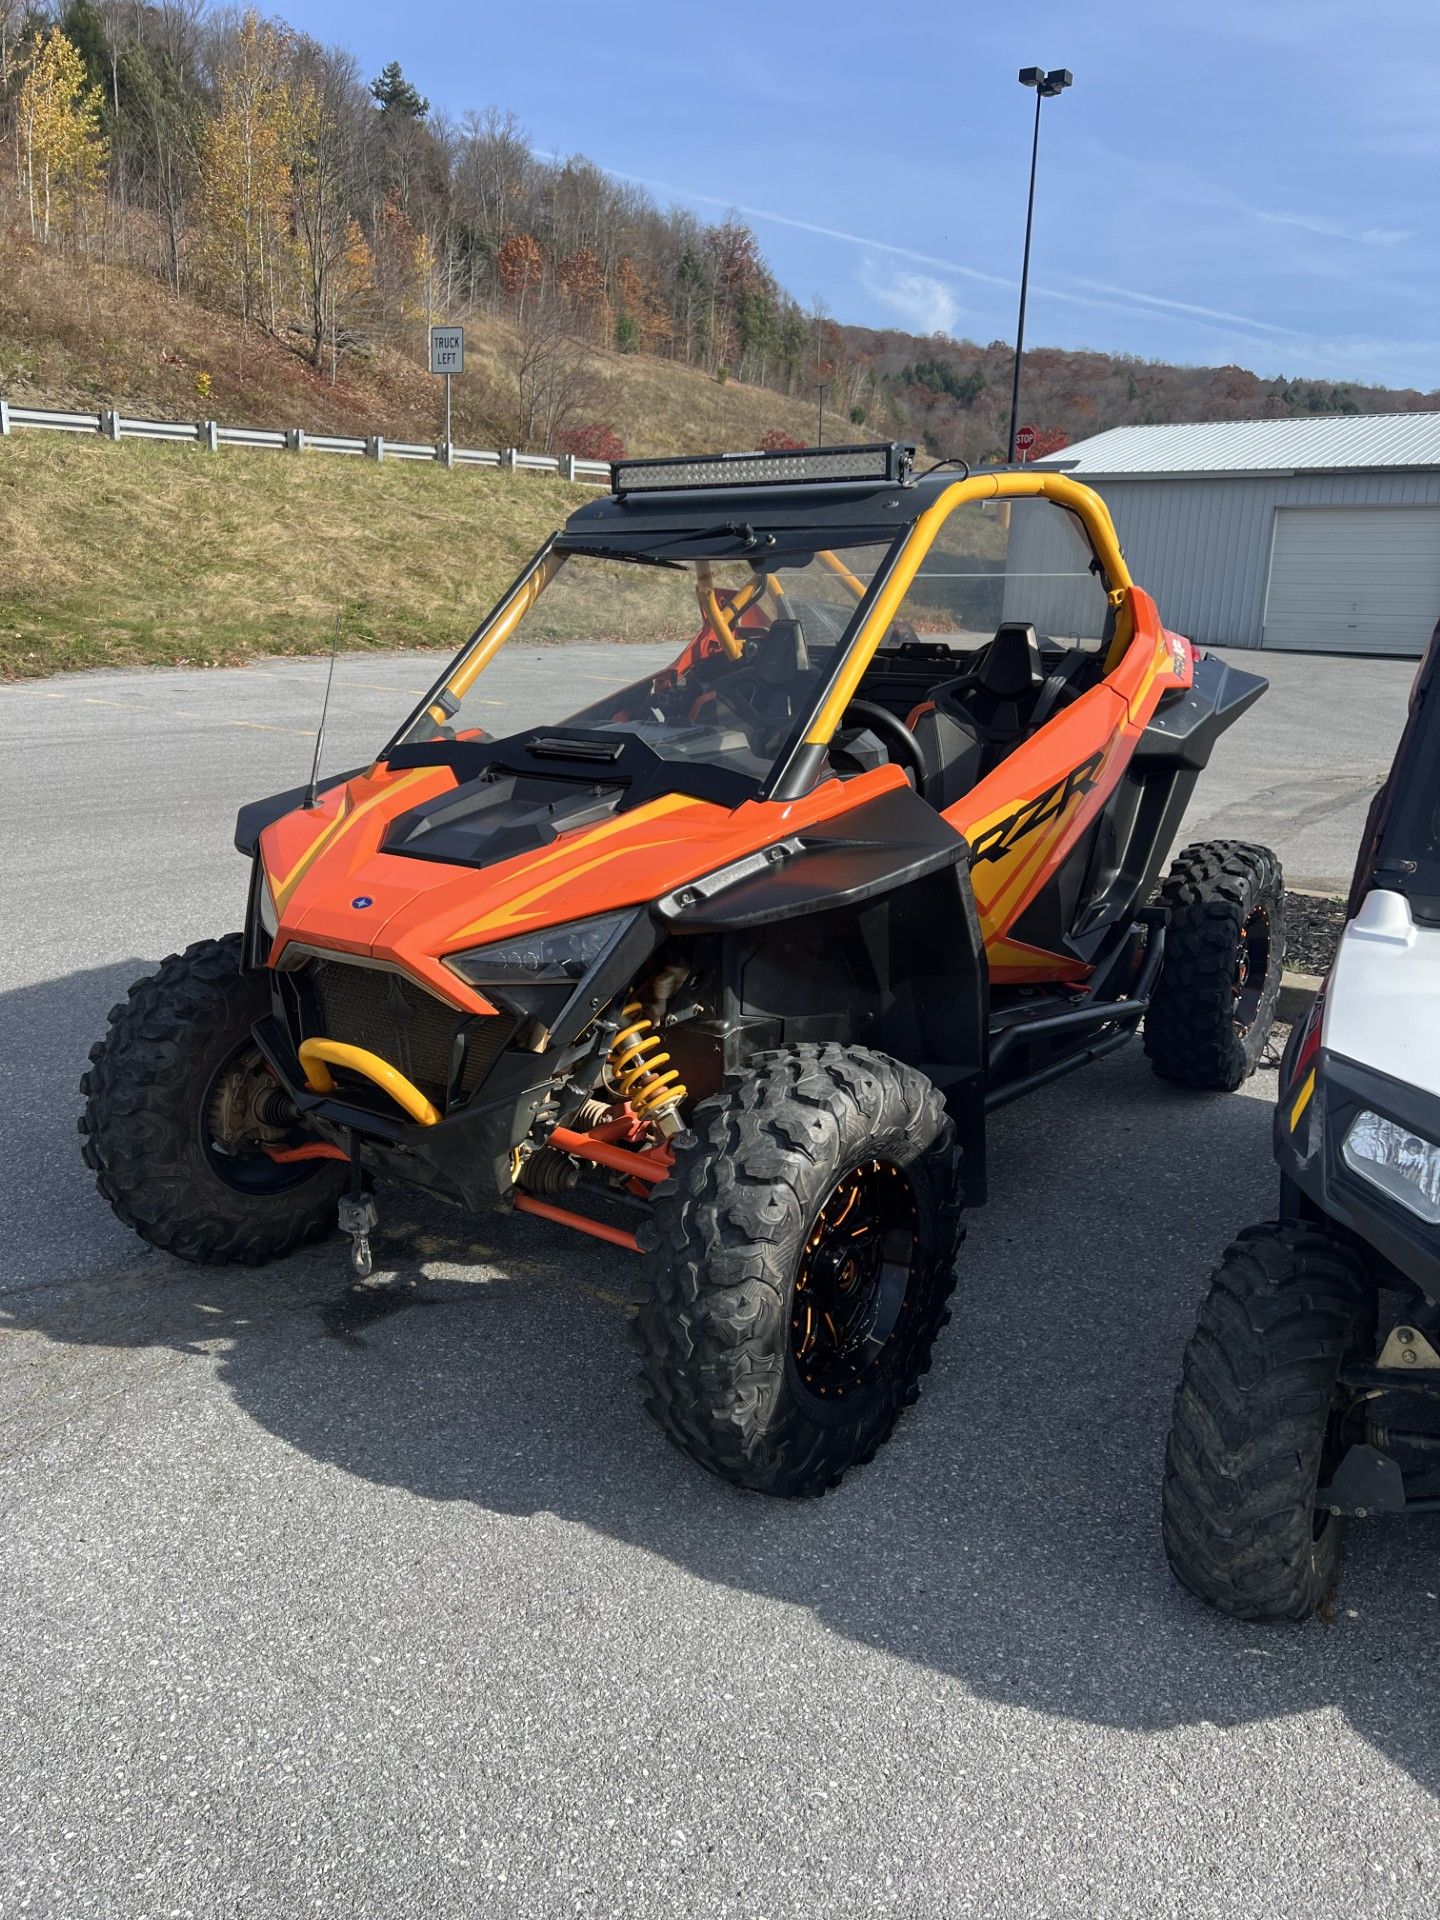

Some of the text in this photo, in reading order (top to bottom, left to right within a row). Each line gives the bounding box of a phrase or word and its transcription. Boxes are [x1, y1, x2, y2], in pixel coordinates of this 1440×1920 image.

[434, 337, 460, 349] TRUCK
[437, 353, 456, 365] LEFT
[1016, 434, 1034, 444] STOP
[968, 751, 1104, 873] RZR
